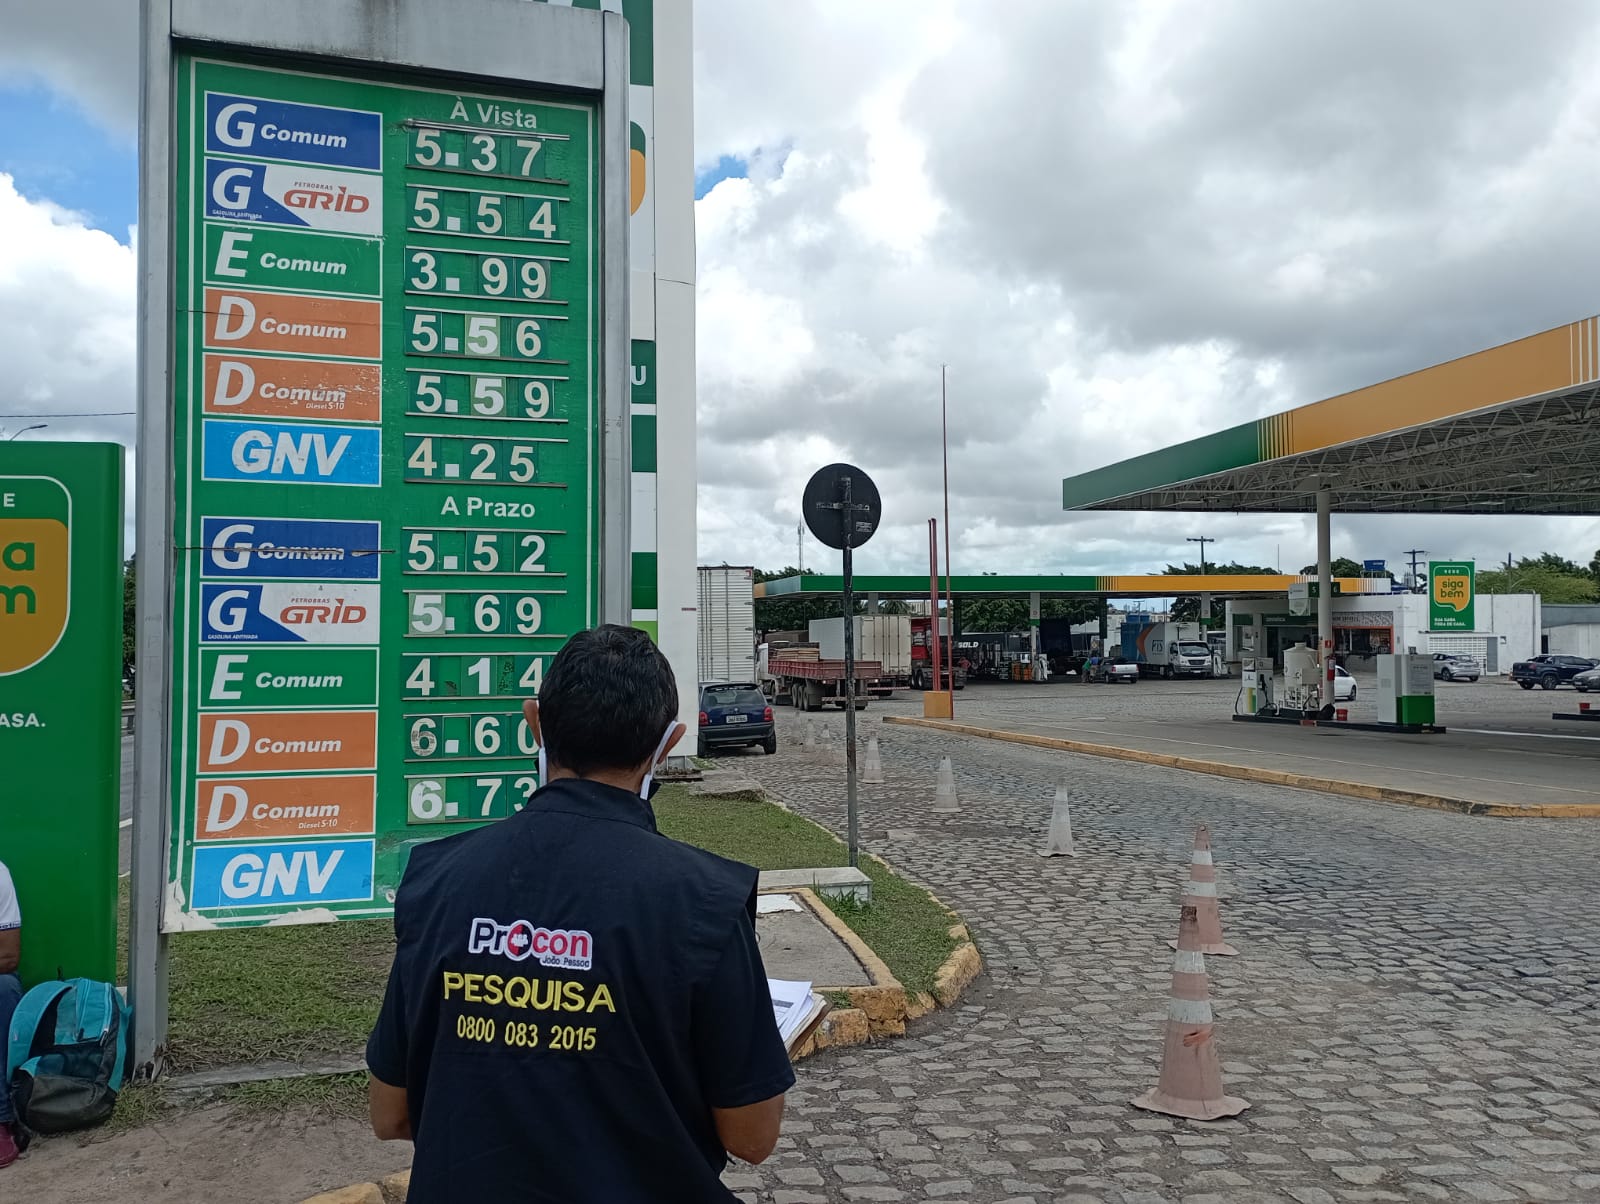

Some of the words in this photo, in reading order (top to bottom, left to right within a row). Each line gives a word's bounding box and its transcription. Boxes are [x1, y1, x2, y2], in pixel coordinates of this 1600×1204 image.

[215, 103, 257, 148] G
[261, 124, 347, 149] Comum
[450, 96, 469, 121] À
[477, 103, 537, 129] Vista
[415, 129, 542, 176] 5.37
[212, 168, 253, 210] G
[284, 185, 369, 213] GRID
[294, 181, 333, 191] PETROBRAS
[414, 190, 556, 238] 5.54
[215, 231, 253, 277] E
[260, 252, 347, 275] Comum
[411, 252, 547, 299] 3.99
[213, 296, 256, 341] D
[260, 318, 347, 339] Comum
[411, 315, 542, 357] 5.56
[213, 361, 256, 406] D
[260, 382, 347, 403] Comum
[415, 375, 550, 418] 5.59
[231, 429, 352, 476] GNV
[408, 437, 535, 483] 4.25
[440, 496, 460, 517] A
[466, 497, 536, 518] Prazo
[211, 524, 255, 570] G
[257, 541, 345, 561] Comum
[408, 533, 546, 572] 5.52
[1440, 588, 1464, 598] bem
[1442, 578, 1464, 590] siga
[207, 590, 250, 633] G
[280, 598, 367, 624] GRID
[412, 594, 541, 635] 5.69
[209, 654, 249, 700] E
[256, 672, 343, 688] Comum
[207, 720, 251, 765] D
[254, 737, 342, 755] Comum
[410, 716, 539, 757] 6.60
[205, 786, 249, 832] D
[252, 802, 340, 820] Comum
[221, 850, 345, 899] GNV
[471, 920, 591, 960] Procon
[542, 955, 560, 966] João
[563, 957, 590, 968] Pessoa
[443, 971, 616, 1013] PESQUISA
[457, 1014, 495, 1043] 0800
[504, 1020, 539, 1048] 083
[549, 1025, 597, 1051] 2015
